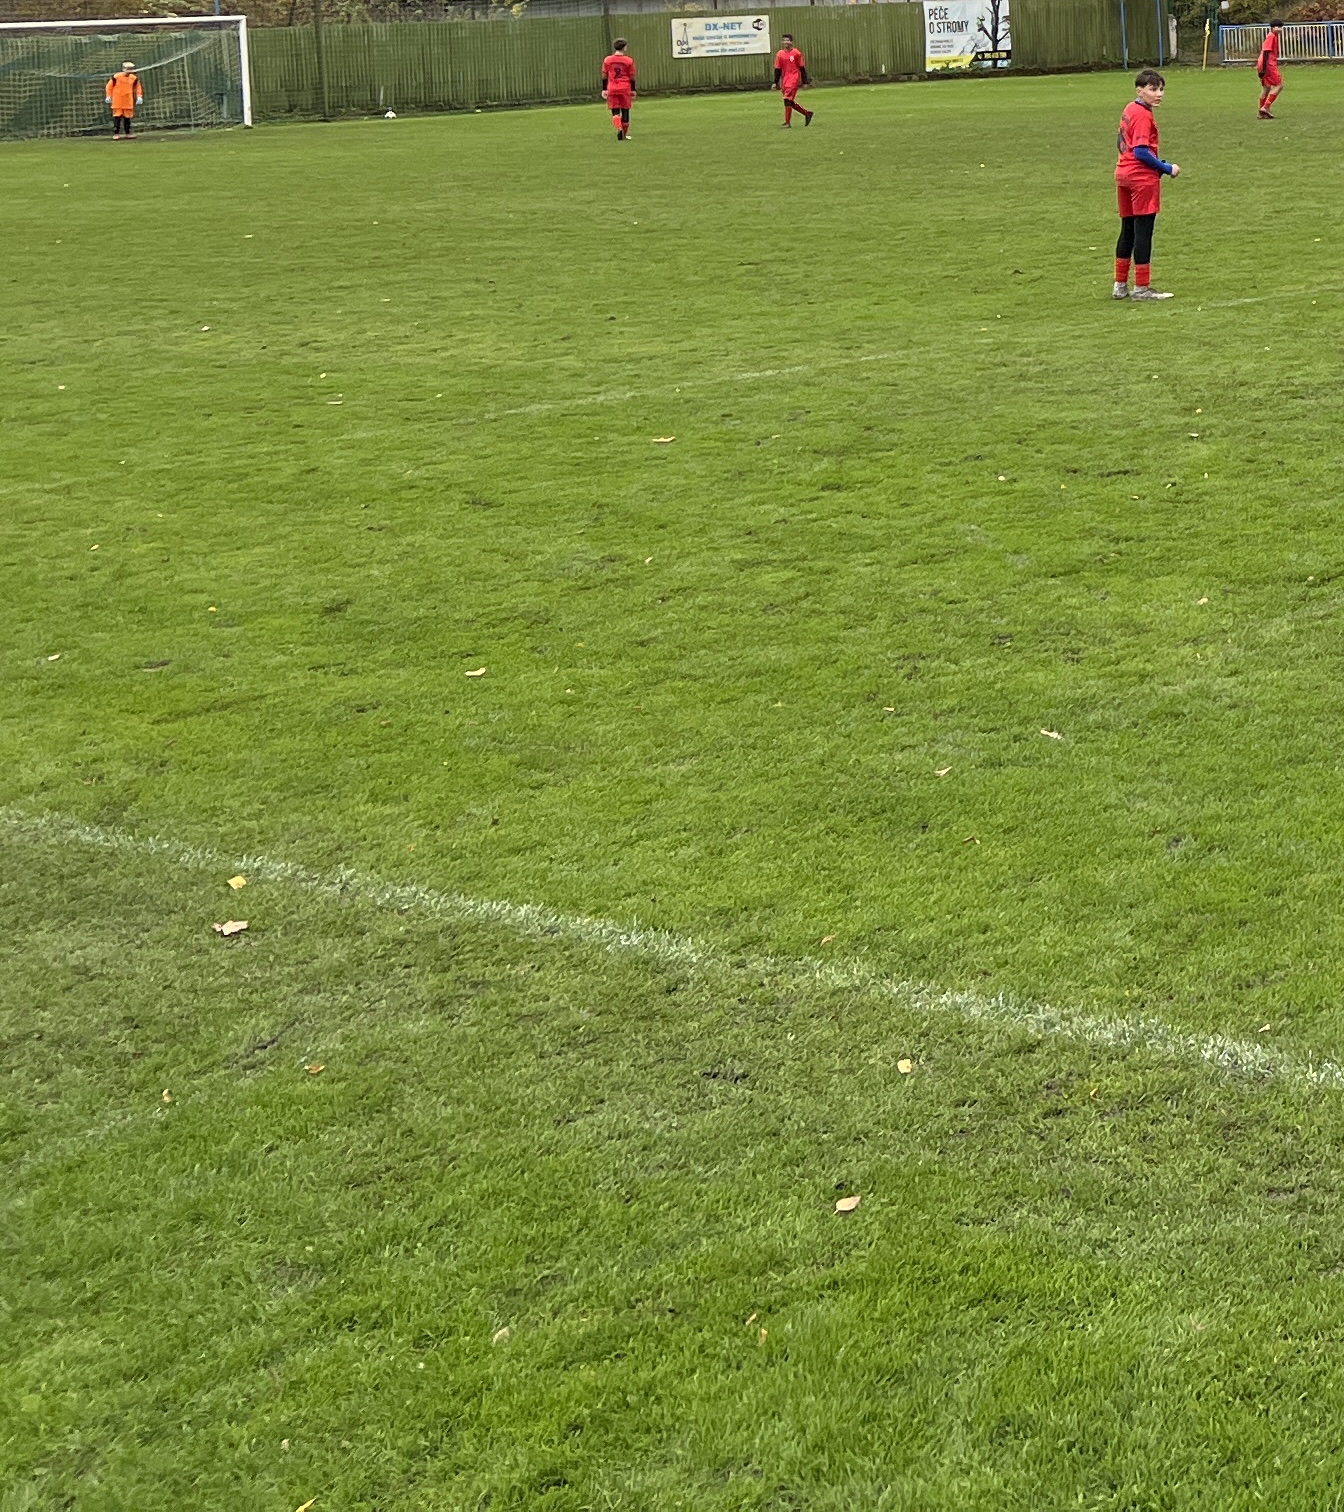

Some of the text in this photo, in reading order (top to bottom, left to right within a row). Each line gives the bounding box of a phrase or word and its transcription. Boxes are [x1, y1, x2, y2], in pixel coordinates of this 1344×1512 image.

[704, 21, 743, 32] DX-NET
[928, 20, 970, 34] O STROMY
